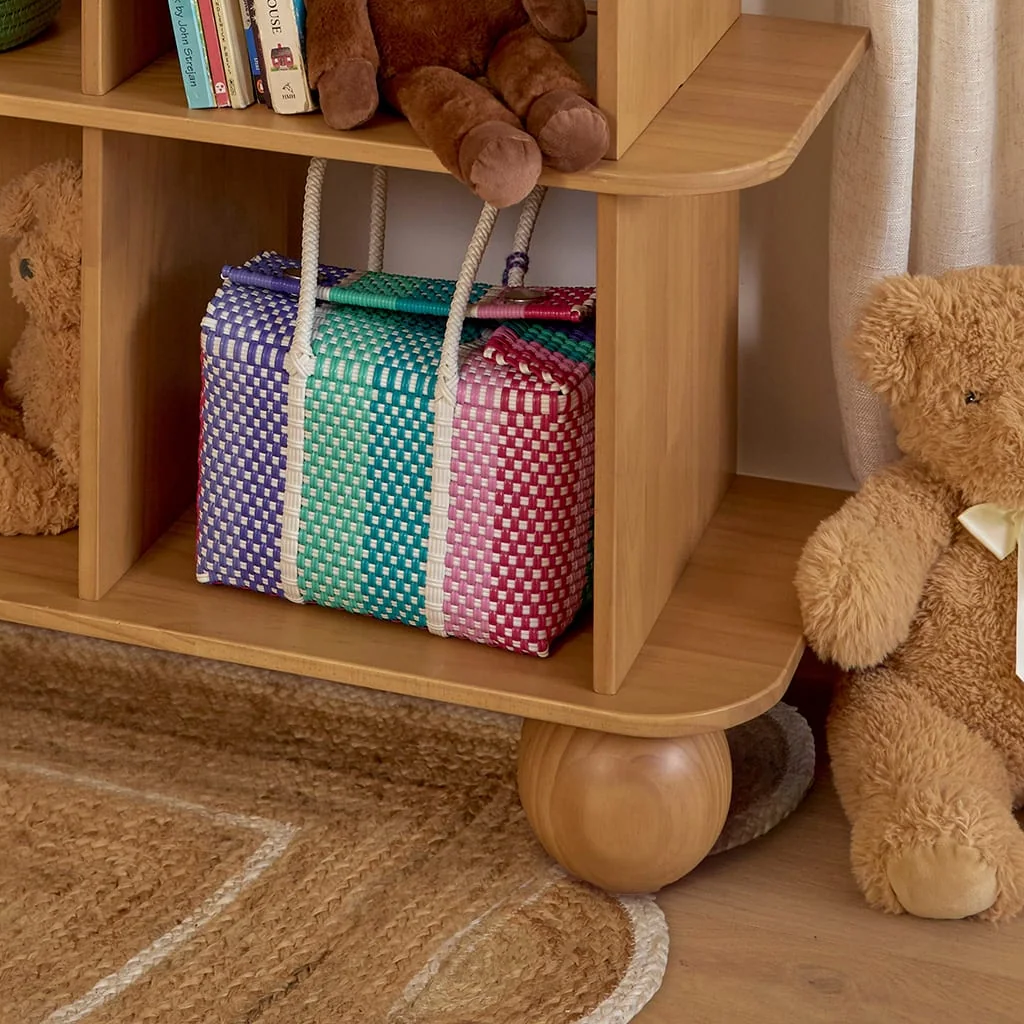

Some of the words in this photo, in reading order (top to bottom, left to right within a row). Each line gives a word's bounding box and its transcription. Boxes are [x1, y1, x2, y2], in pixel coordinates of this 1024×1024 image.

[175, 6, 184, 18] by
[178, 20, 189, 45] John
[184, 48, 197, 87] Strejan
